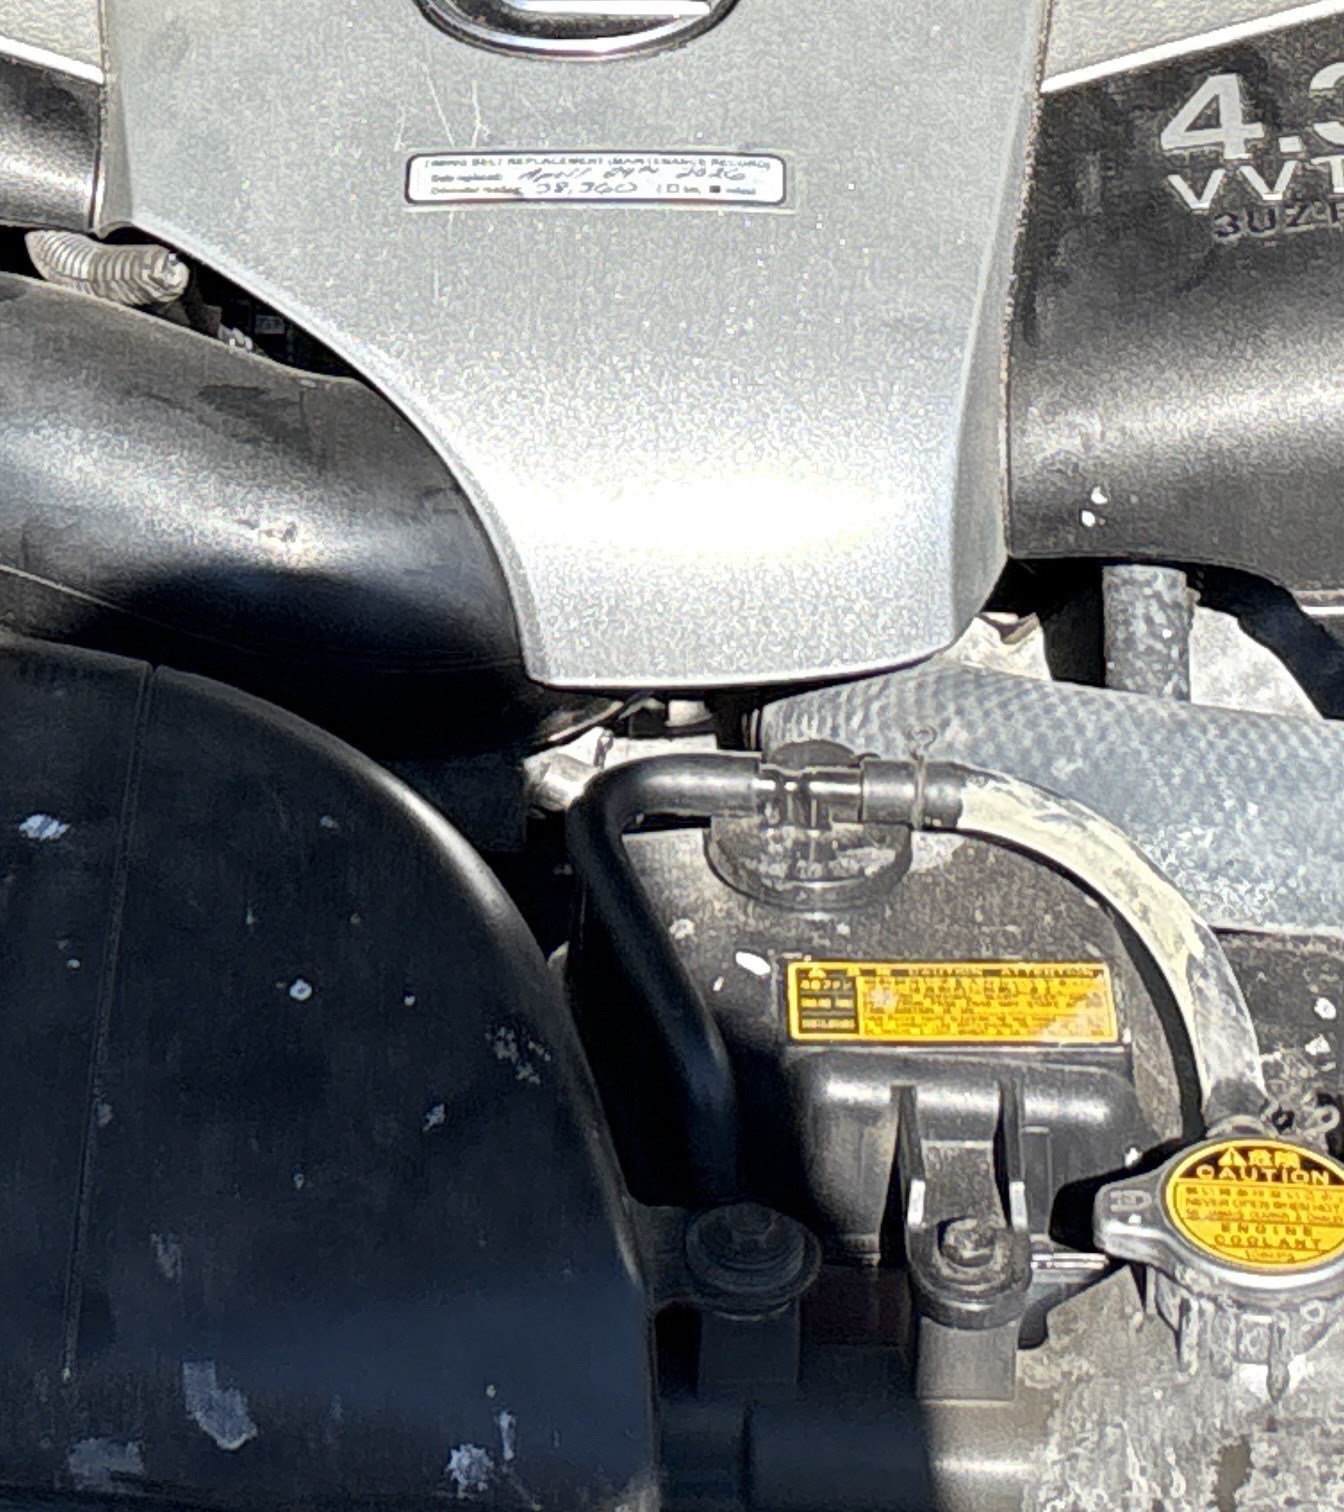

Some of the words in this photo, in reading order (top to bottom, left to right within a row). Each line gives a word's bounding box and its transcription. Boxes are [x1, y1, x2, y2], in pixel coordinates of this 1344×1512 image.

[1195, 1164, 1330, 1186] CAUTION
[1220, 1222, 1313, 1237] ENGINE
[1213, 1234, 1322, 1251] COOLANT
